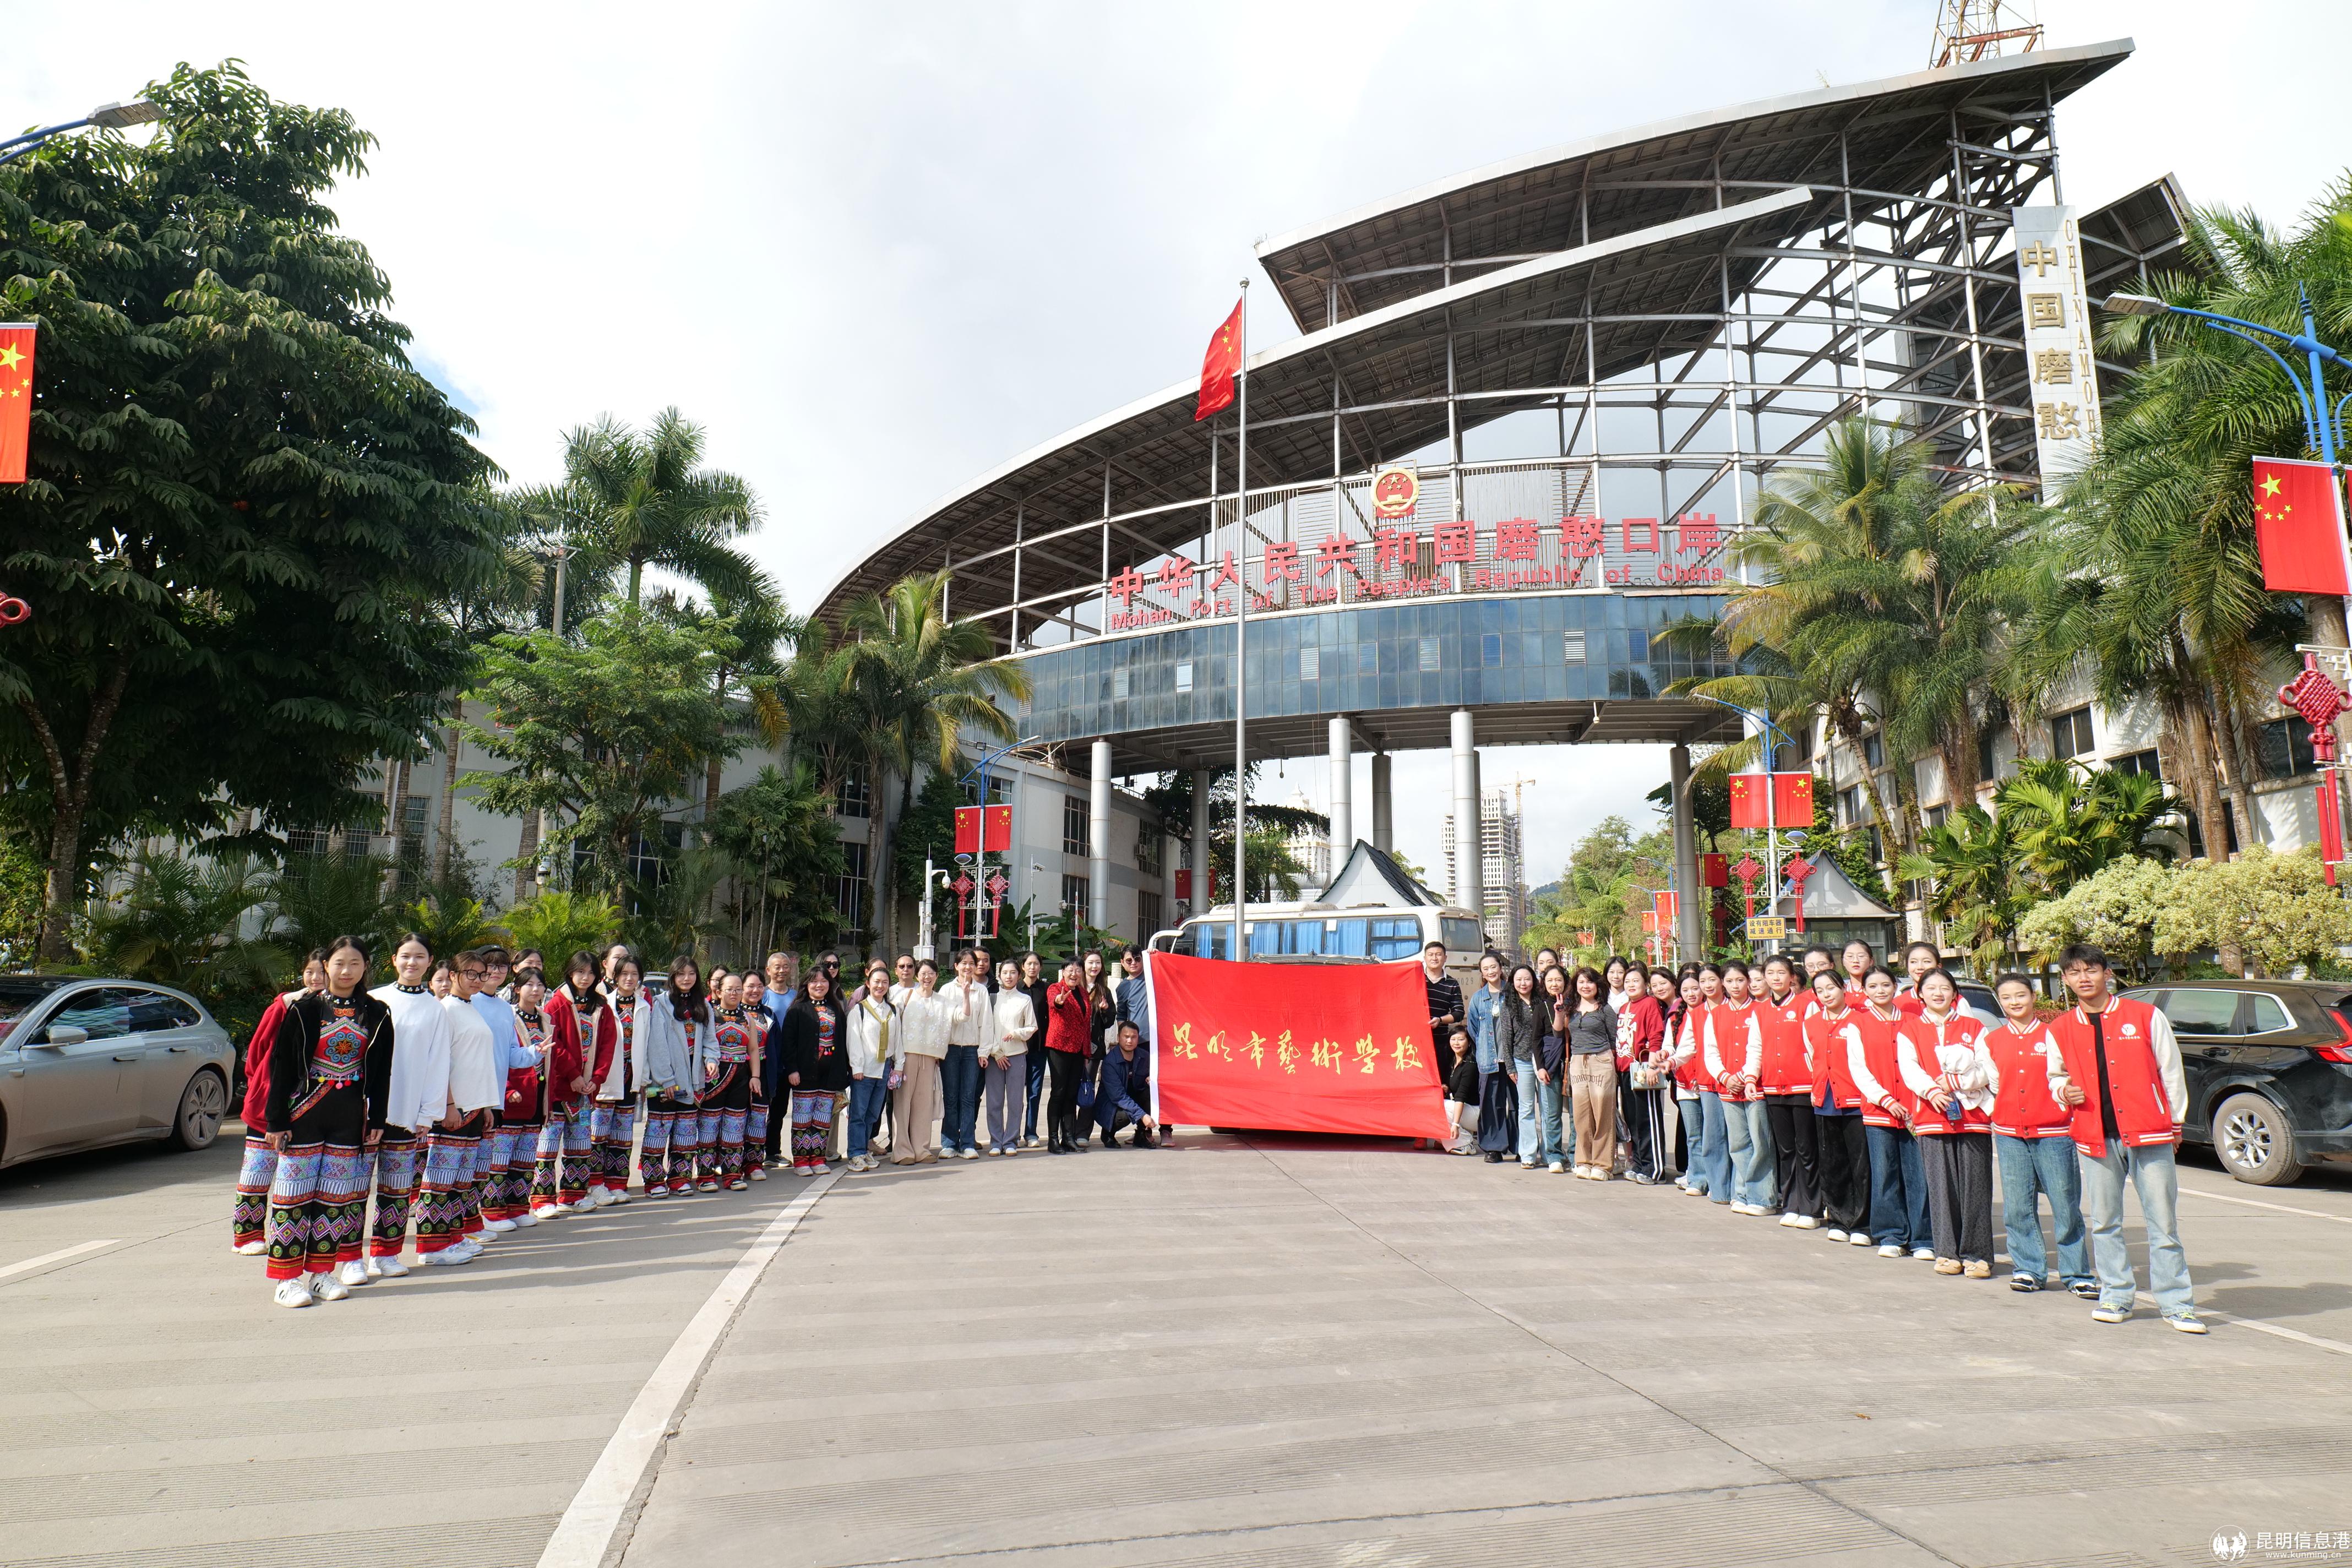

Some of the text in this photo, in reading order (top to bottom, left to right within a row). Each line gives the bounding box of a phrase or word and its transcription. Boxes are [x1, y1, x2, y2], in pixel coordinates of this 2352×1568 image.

[2021, 240, 2081, 440] 中国磨憨
[1111, 562, 1724, 630] Mohan Port of The People's Republic of China
[1112, 512, 1721, 606] 中华人民共和国磨憨口岸
